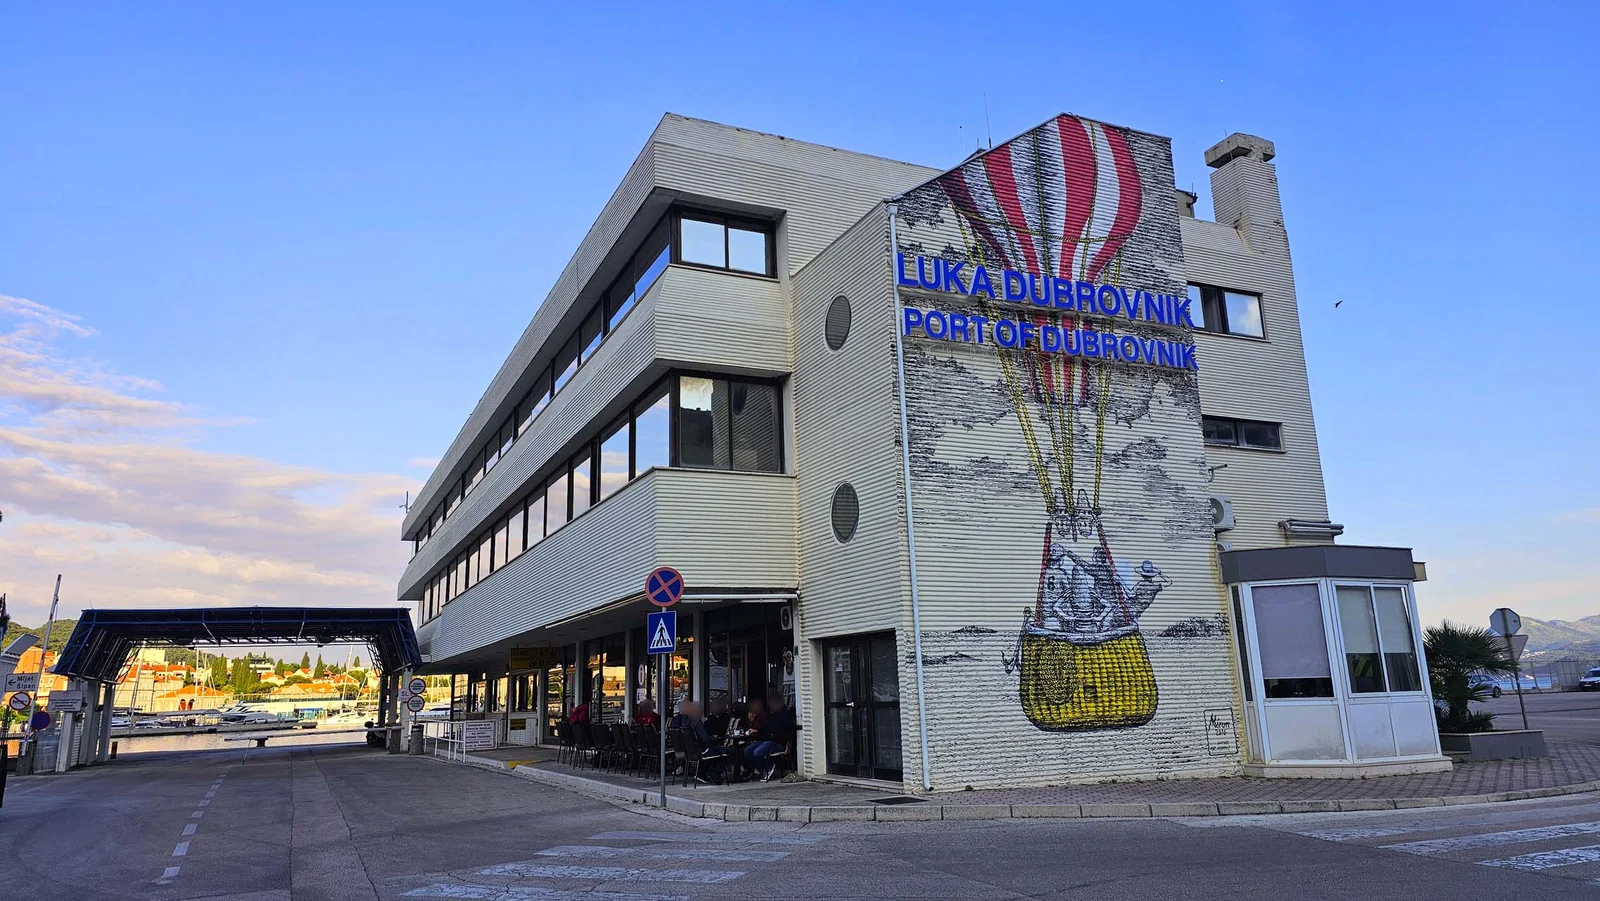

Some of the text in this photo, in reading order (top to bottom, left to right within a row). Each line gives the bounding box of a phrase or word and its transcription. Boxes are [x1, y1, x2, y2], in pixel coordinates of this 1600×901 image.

[896, 252, 1197, 328] LUKA DUBROVNIK
[902, 307, 1199, 371] PORT OF DUBROVNIK
